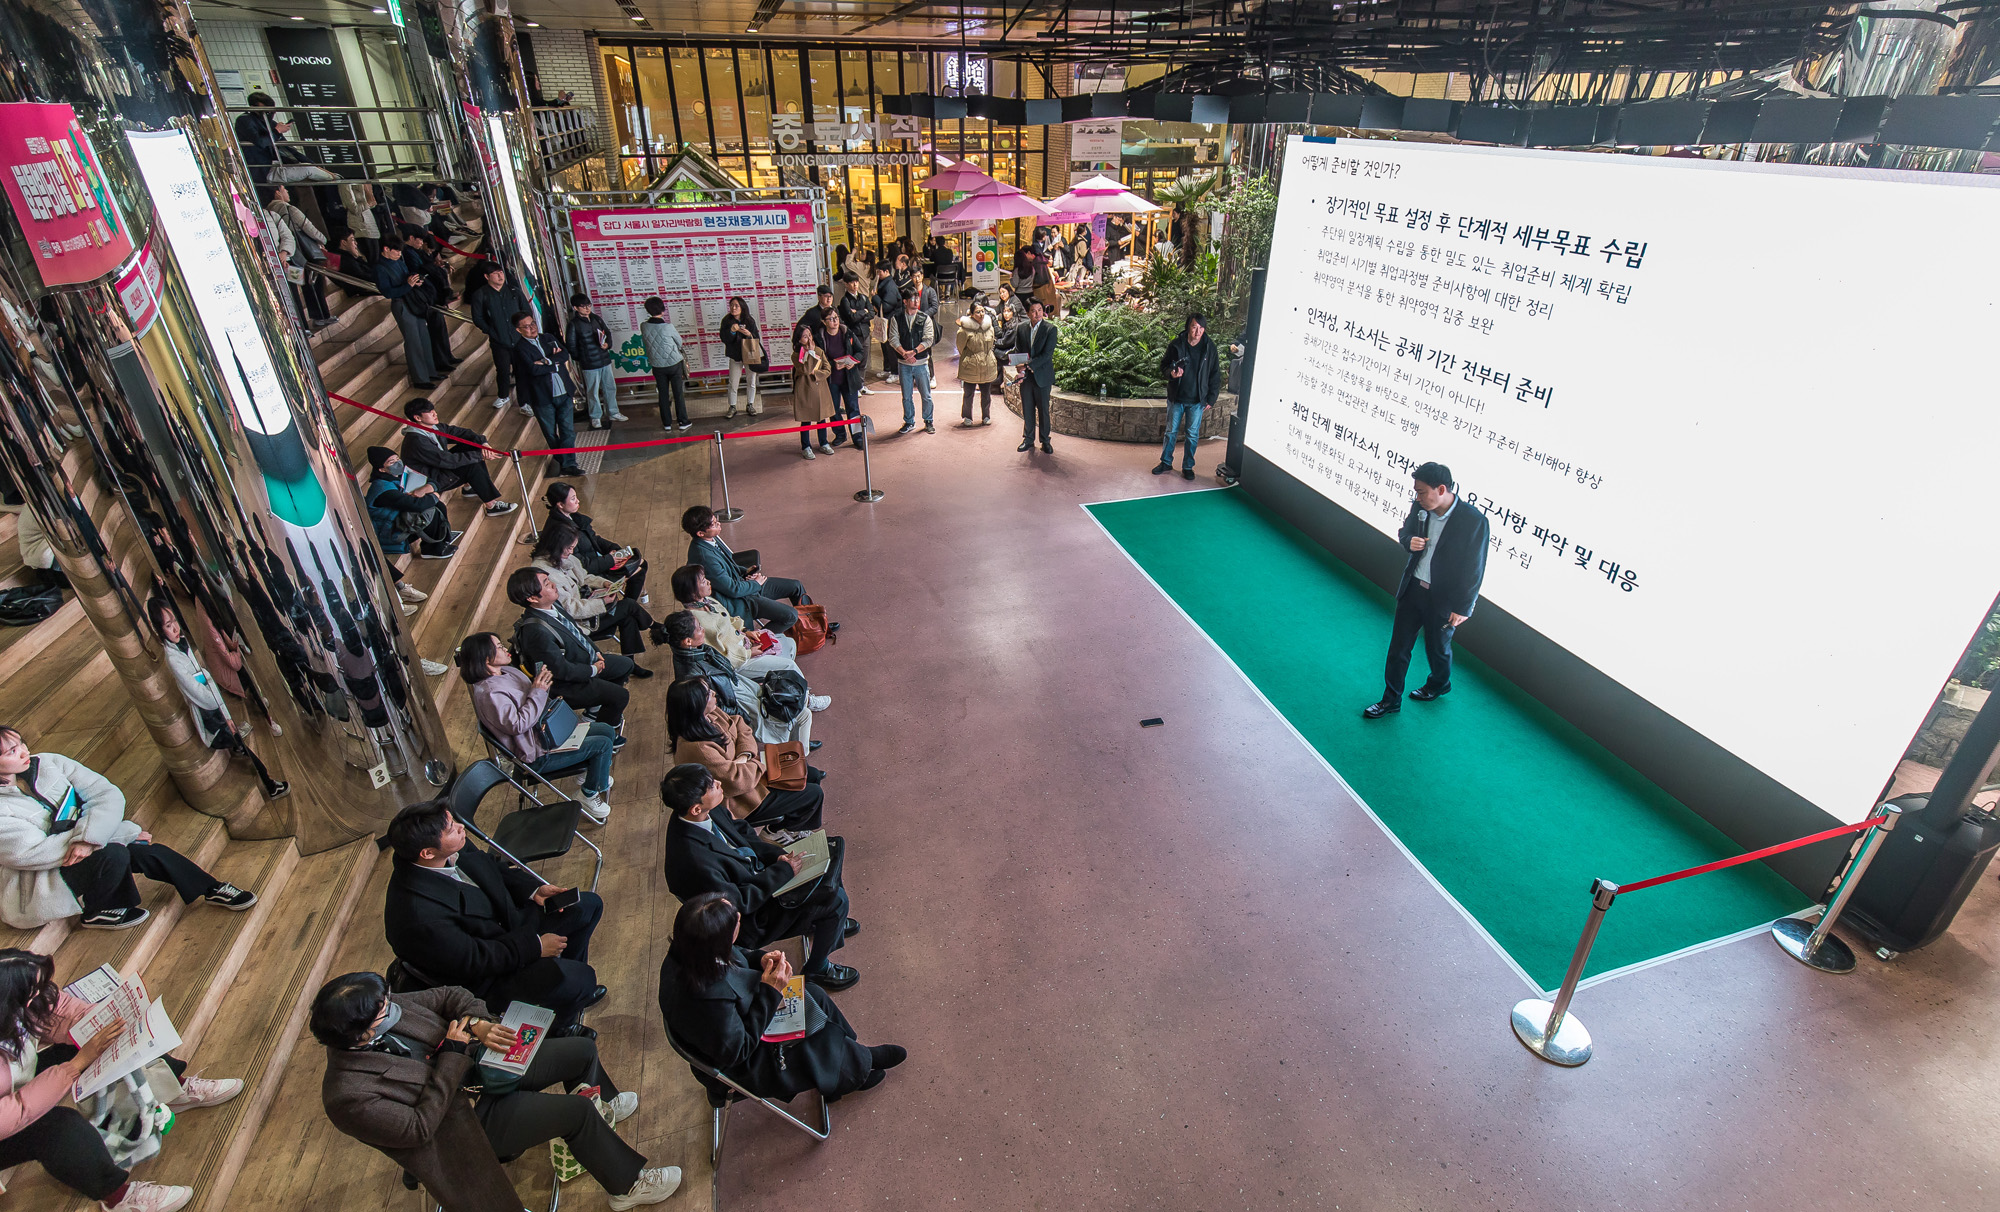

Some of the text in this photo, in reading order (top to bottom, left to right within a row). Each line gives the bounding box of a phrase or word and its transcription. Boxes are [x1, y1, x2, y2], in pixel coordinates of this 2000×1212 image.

[288, 56, 332, 66] JONGNO
[772, 113, 919, 150] 종로서적
[776, 154, 920, 166] JONGNOBOOKS.COM
[1301, 155, 1401, 179] 어떻게 준비할 것인가?
[602, 220, 622, 231] 잡다
[623, 219, 650, 230] 서울시
[651, 217, 702, 229] 일자리박람회
[704, 214, 788, 228] 현장채용게시대
[1326, 196, 1648, 269] 장기적인 목표 설정 후 단계적 세부목표 수립
[1317, 248, 1554, 320] 취업준비 시기별 취업과정별 준비사항에 대한 정리
[1321, 225, 1632, 305] 주단위 일정계획 수립을 통한 밀도 있는 취업준비 체계 확립
[1314, 270, 1494, 336] 취약영역 분석을 통한 취약영역 집중 보완
[624, 347, 646, 357] JOB
[1303, 332, 1486, 415] 공채기간은 접수기간이지 준비 기간이 아니다!
[1307, 307, 1554, 409] 인적성, 자소서는 공채 기간 전부터 준비
[1296, 371, 1420, 437] 가능할 경우 면접관련 준비도 병행
[1336, 368, 1373, 393] 기존항목을
[1414, 400, 1448, 426] 인적성은
[1452, 416, 1483, 440] 장기간
[1486, 430, 1520, 454] 꾸준히
[1522, 446, 1572, 476] 준비해야
[1576, 467, 1604, 490] 향상
[1288, 424, 1302, 440] 단계
[1304, 434, 1312, 446] 별
[1314, 440, 1345, 465] 세분화된
[1347, 458, 1382, 486] 요구사항
[1385, 478, 1405, 498] 파악
[1506, 546, 1534, 570] 수립
[1291, 401, 1310, 422] 취업
[1312, 412, 1332, 433] 단계
[1334, 422, 1381, 460] 별(자소서,
[1532, 525, 1569, 557] 파악
[1574, 544, 1593, 570] 및
[1598, 559, 1640, 593] 대응
[1301, 452, 1315, 470] 면접
[1316, 462, 1333, 480] 유형
[1334, 472, 1343, 486] 별
[1344, 478, 1380, 507] 대응전략
